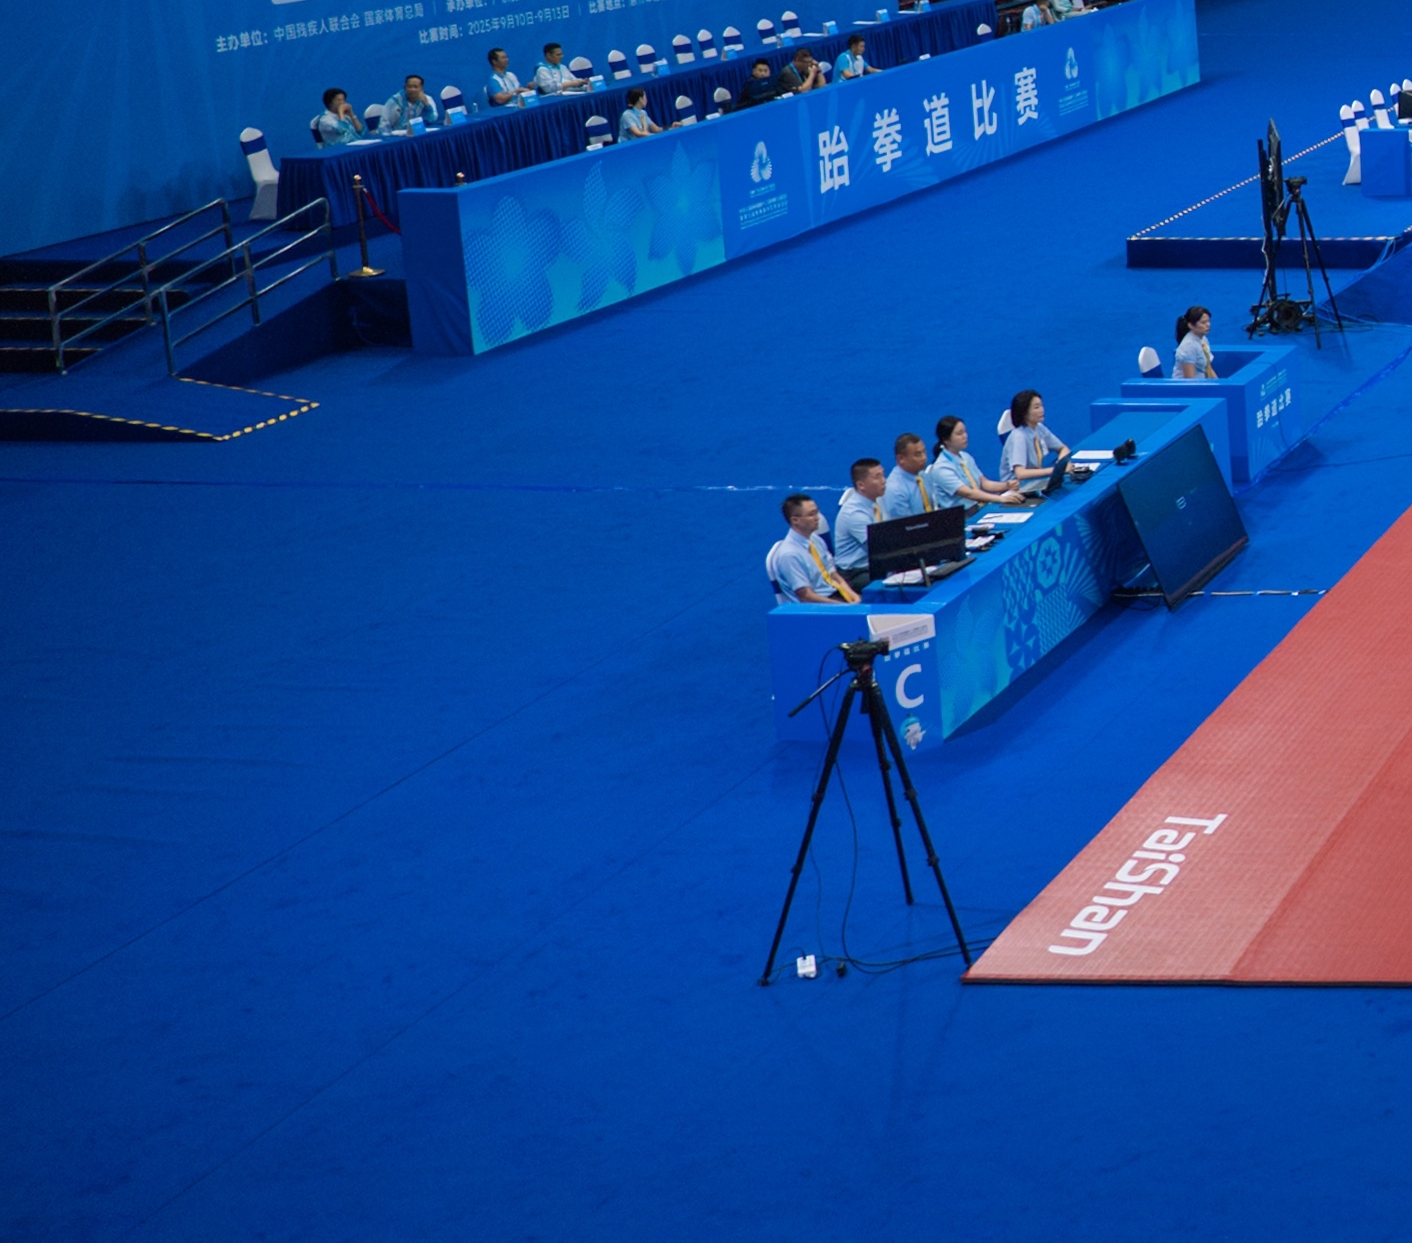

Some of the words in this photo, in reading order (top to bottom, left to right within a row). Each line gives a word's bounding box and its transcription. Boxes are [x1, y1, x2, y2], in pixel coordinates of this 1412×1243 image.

[817, 66, 1039, 194] 跆拳道比赛
[895, 663, 925, 709] C
[1048, 813, 1228, 956] TaiShan
